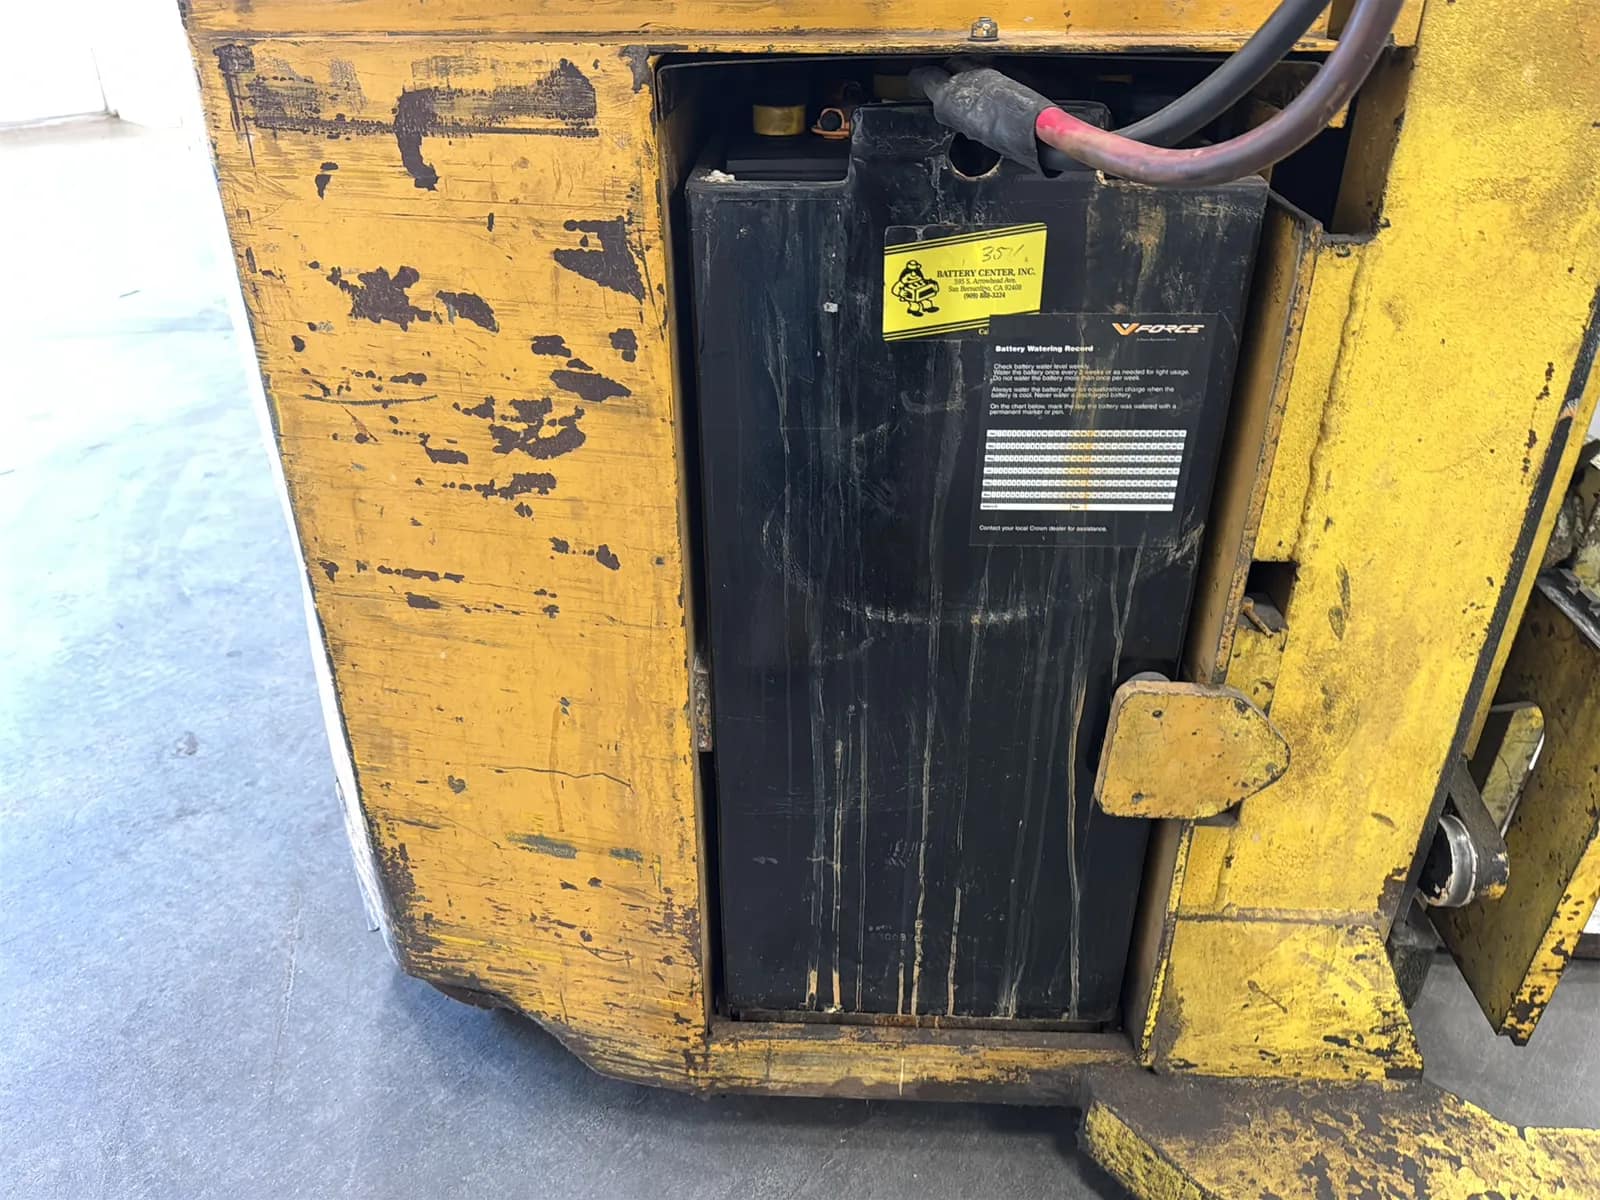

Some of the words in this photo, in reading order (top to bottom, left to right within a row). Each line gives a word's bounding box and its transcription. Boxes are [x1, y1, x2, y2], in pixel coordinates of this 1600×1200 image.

[936, 269, 976, 278] BATTERY
[978, 268, 1015, 277] CENTER,
[1018, 267, 1036, 276] INC.
[995, 345, 1026, 353] Battery
[1027, 345, 1063, 353] Watering
